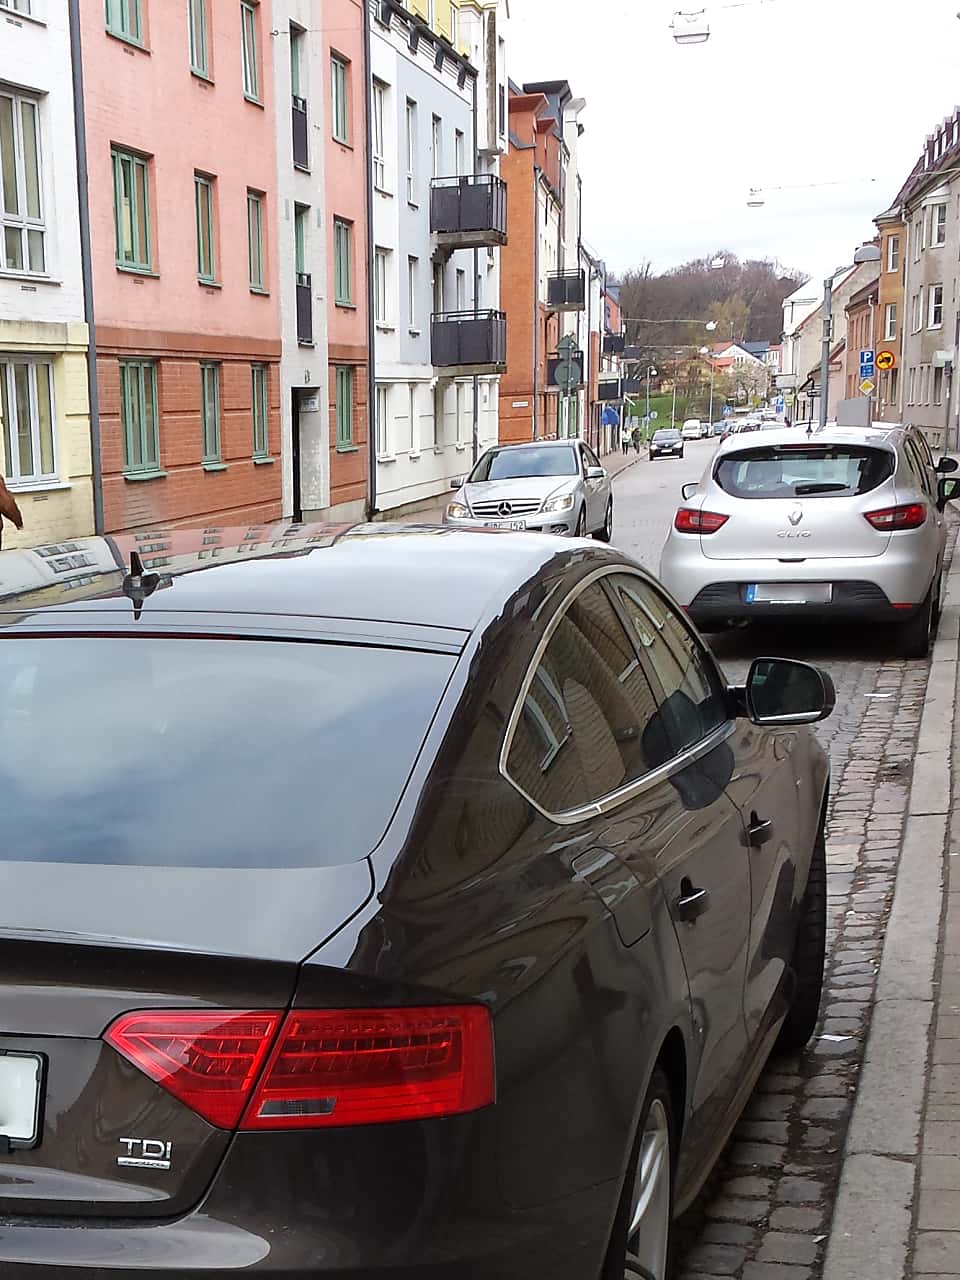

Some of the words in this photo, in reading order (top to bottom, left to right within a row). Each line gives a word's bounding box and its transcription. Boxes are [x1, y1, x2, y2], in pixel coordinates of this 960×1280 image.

[864, 352, 872, 363] P
[777, 530, 811, 538] CLIO
[119, 1137, 172, 1158] TDI
